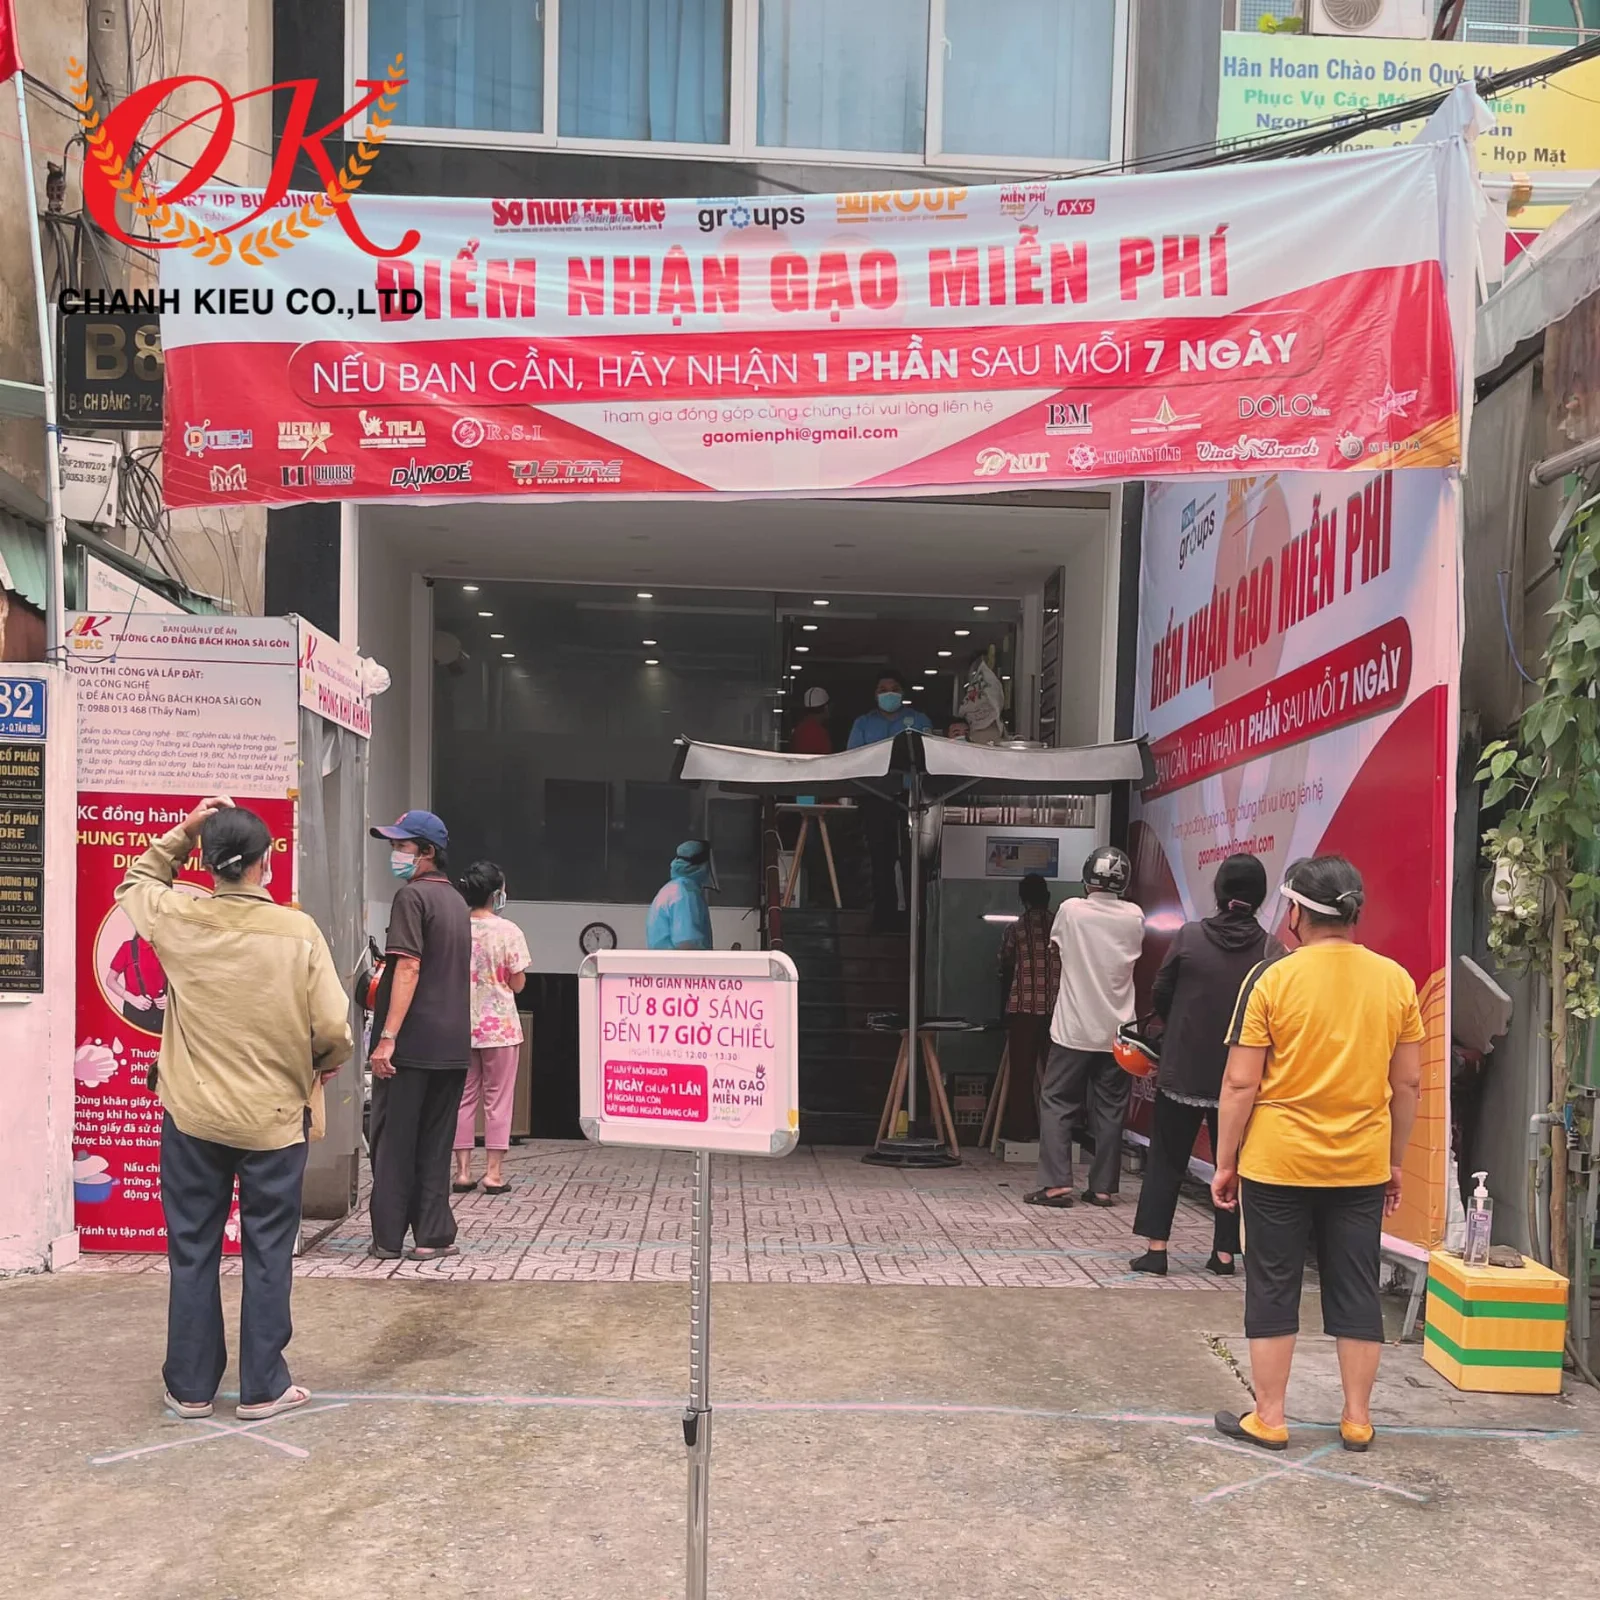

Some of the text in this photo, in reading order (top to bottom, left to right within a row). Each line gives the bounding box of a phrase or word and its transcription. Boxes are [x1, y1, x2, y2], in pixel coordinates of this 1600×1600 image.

[1224, 56, 1262, 77] Hân
[1270, 57, 1318, 78] Hoan
[1326, 58, 1376, 80] Chào
[1384, 60, 1422, 82] Đón
[1430, 62, 1464, 84] Quý
[1244, 89, 1370, 110] Phục Vụ Các
[1494, 147, 1566, 167] Họp Mặt
[1044, 205, 1054, 217] by
[1060, 201, 1093, 214] AXYS
[374, 222, 1230, 326] ĐIỂM NHẬN GẠO MIỄN PHÍ
[312, 330, 1298, 400] NẾU BẠN CẦN, HÃY NHẬN 1 PHẦN SAU MỖI 7 NGÀY
[602, 398, 994, 424] Tham gia đóng góp cùng chúng tôi vui lòng liên hệ
[1240, 394, 1312, 418] DOLO
[702, 426, 898, 448] gaomienphi@gmail.com
[1185, 584, 1231, 690] NHẬN
[1233, 556, 1274, 668] GẠO
[1278, 490, 1338, 635] MIỄN
[74, 639, 104, 650] BKC
[110, 633, 148, 643] TRƯỜNG
[150, 634, 170, 644] CAO
[199, 635, 222, 646] BÁCH
[224, 637, 250, 647] KHOA
[252, 636, 268, 648] SÀI
[270, 637, 290, 648] GÒN
[101, 667, 116, 676] THI
[118, 666, 146, 677] CÔNG
[147, 666, 160, 677] VÀ
[162, 666, 180, 678] LẮP
[94, 678, 122, 688] CÔNG
[116, 692, 262, 706] CAO BÁCH KHOA GÒN
[1238, 718, 1245, 750] 1
[1248, 690, 1280, 748] PHẦN
[1282, 694, 1305, 733] SAU
[1308, 666, 1336, 724] MỖI
[1339, 671, 1350, 711] 7
[1352, 642, 1402, 706] NGÀY
[88, 704, 200, 717] 0988 013 468 (Thầy Nam)
[102, 804, 144, 825] đồng
[628, 976, 653, 988] THỜI
[656, 978, 682, 990] GIAN
[684, 978, 716, 992] NHẬN
[616, 992, 764, 1020] TỪ 8 GIỜ SÁNG
[603, 1017, 775, 1049] ĐẾN 17 GIỜ CHIỀU
[606, 1078, 702, 1096] 7 NGÀY 1 LẦN
[712, 1078, 766, 1093] ATM GẠO
[102, 1096, 128, 1107] khăn
[130, 1096, 151, 1108] giấy
[744, 1094, 764, 1106] PHÍ
[106, 1110, 122, 1120] khi
[124, 1110, 138, 1120] ho
[100, 1122, 121, 1134] giấy
[99, 1136, 112, 1147] bỏ
[115, 1138, 133, 1147] vào
[124, 1162, 144, 1173] Nấu
[124, 1176, 154, 1188] trứng.
[123, 1190, 150, 1201] động
[107, 1226, 118, 1238] tụ
[120, 1226, 136, 1238] tập
[140, 1226, 155, 1237] nơi
